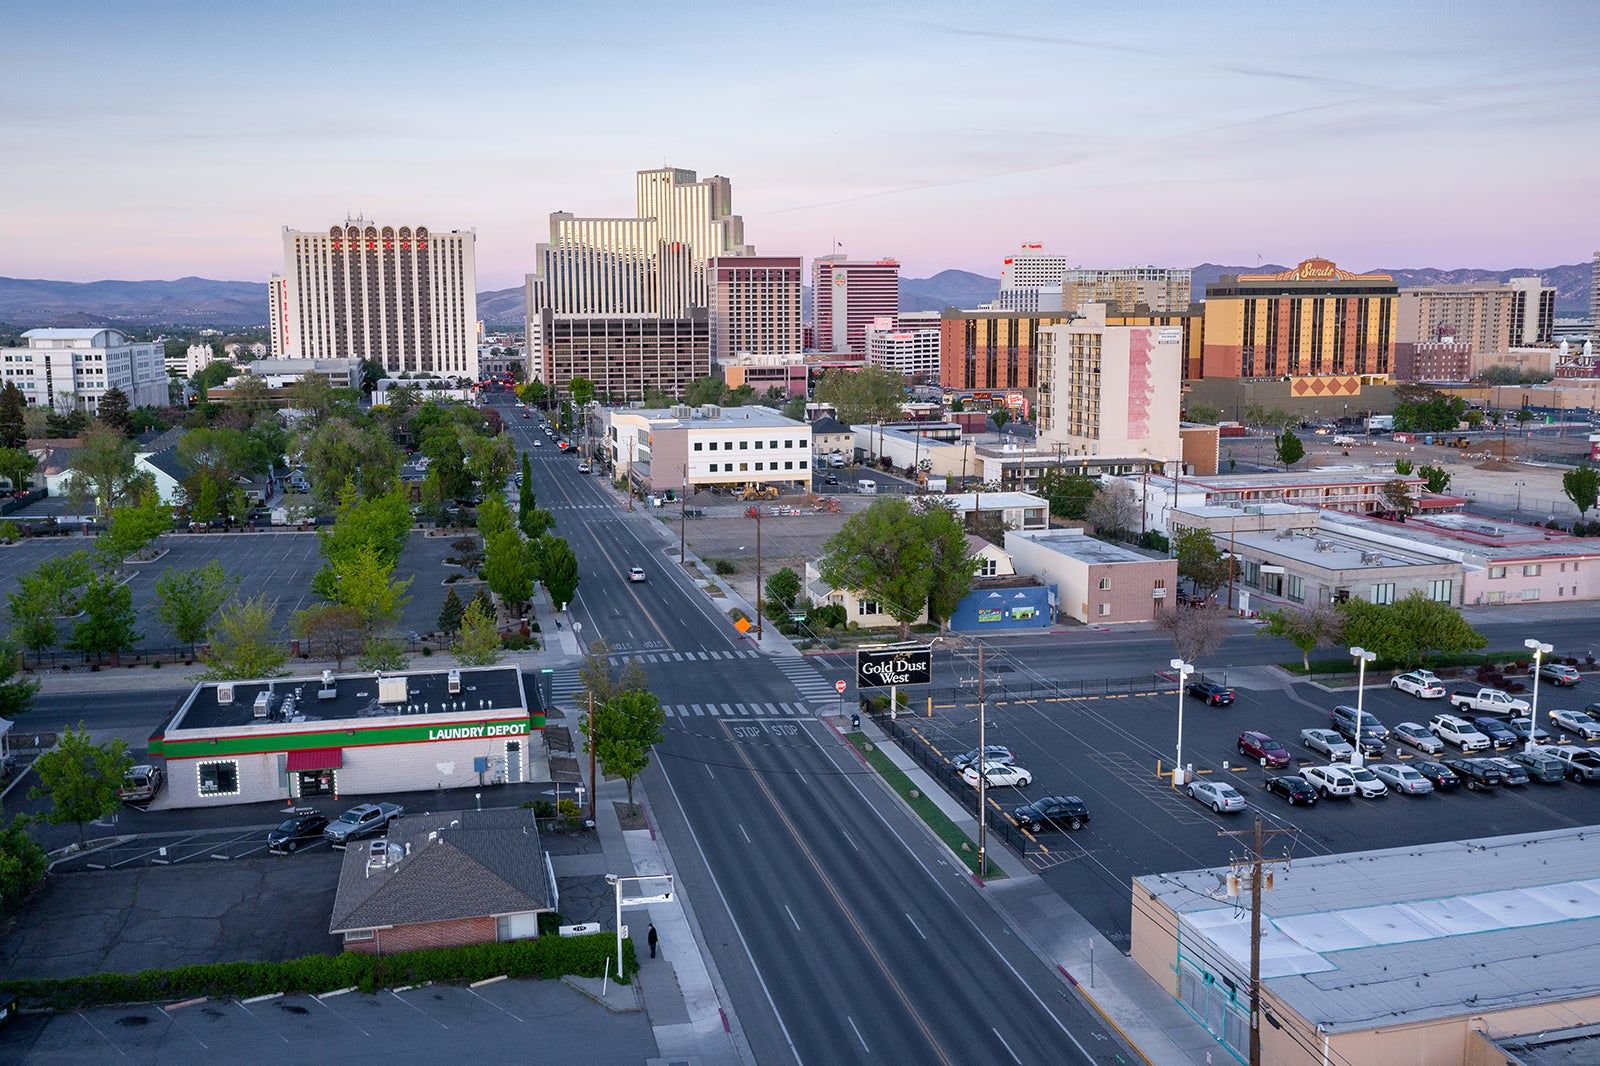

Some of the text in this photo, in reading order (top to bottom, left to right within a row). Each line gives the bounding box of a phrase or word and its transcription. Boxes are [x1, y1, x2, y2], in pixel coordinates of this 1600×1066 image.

[1301, 262, 1334, 278] Sands
[862, 660, 927, 674] Gold Dust
[880, 672, 910, 684] West
[429, 724, 526, 740] LAUNDRY DEPOT
[733, 726, 760, 738] STOP
[771, 724, 798, 736] STOP
